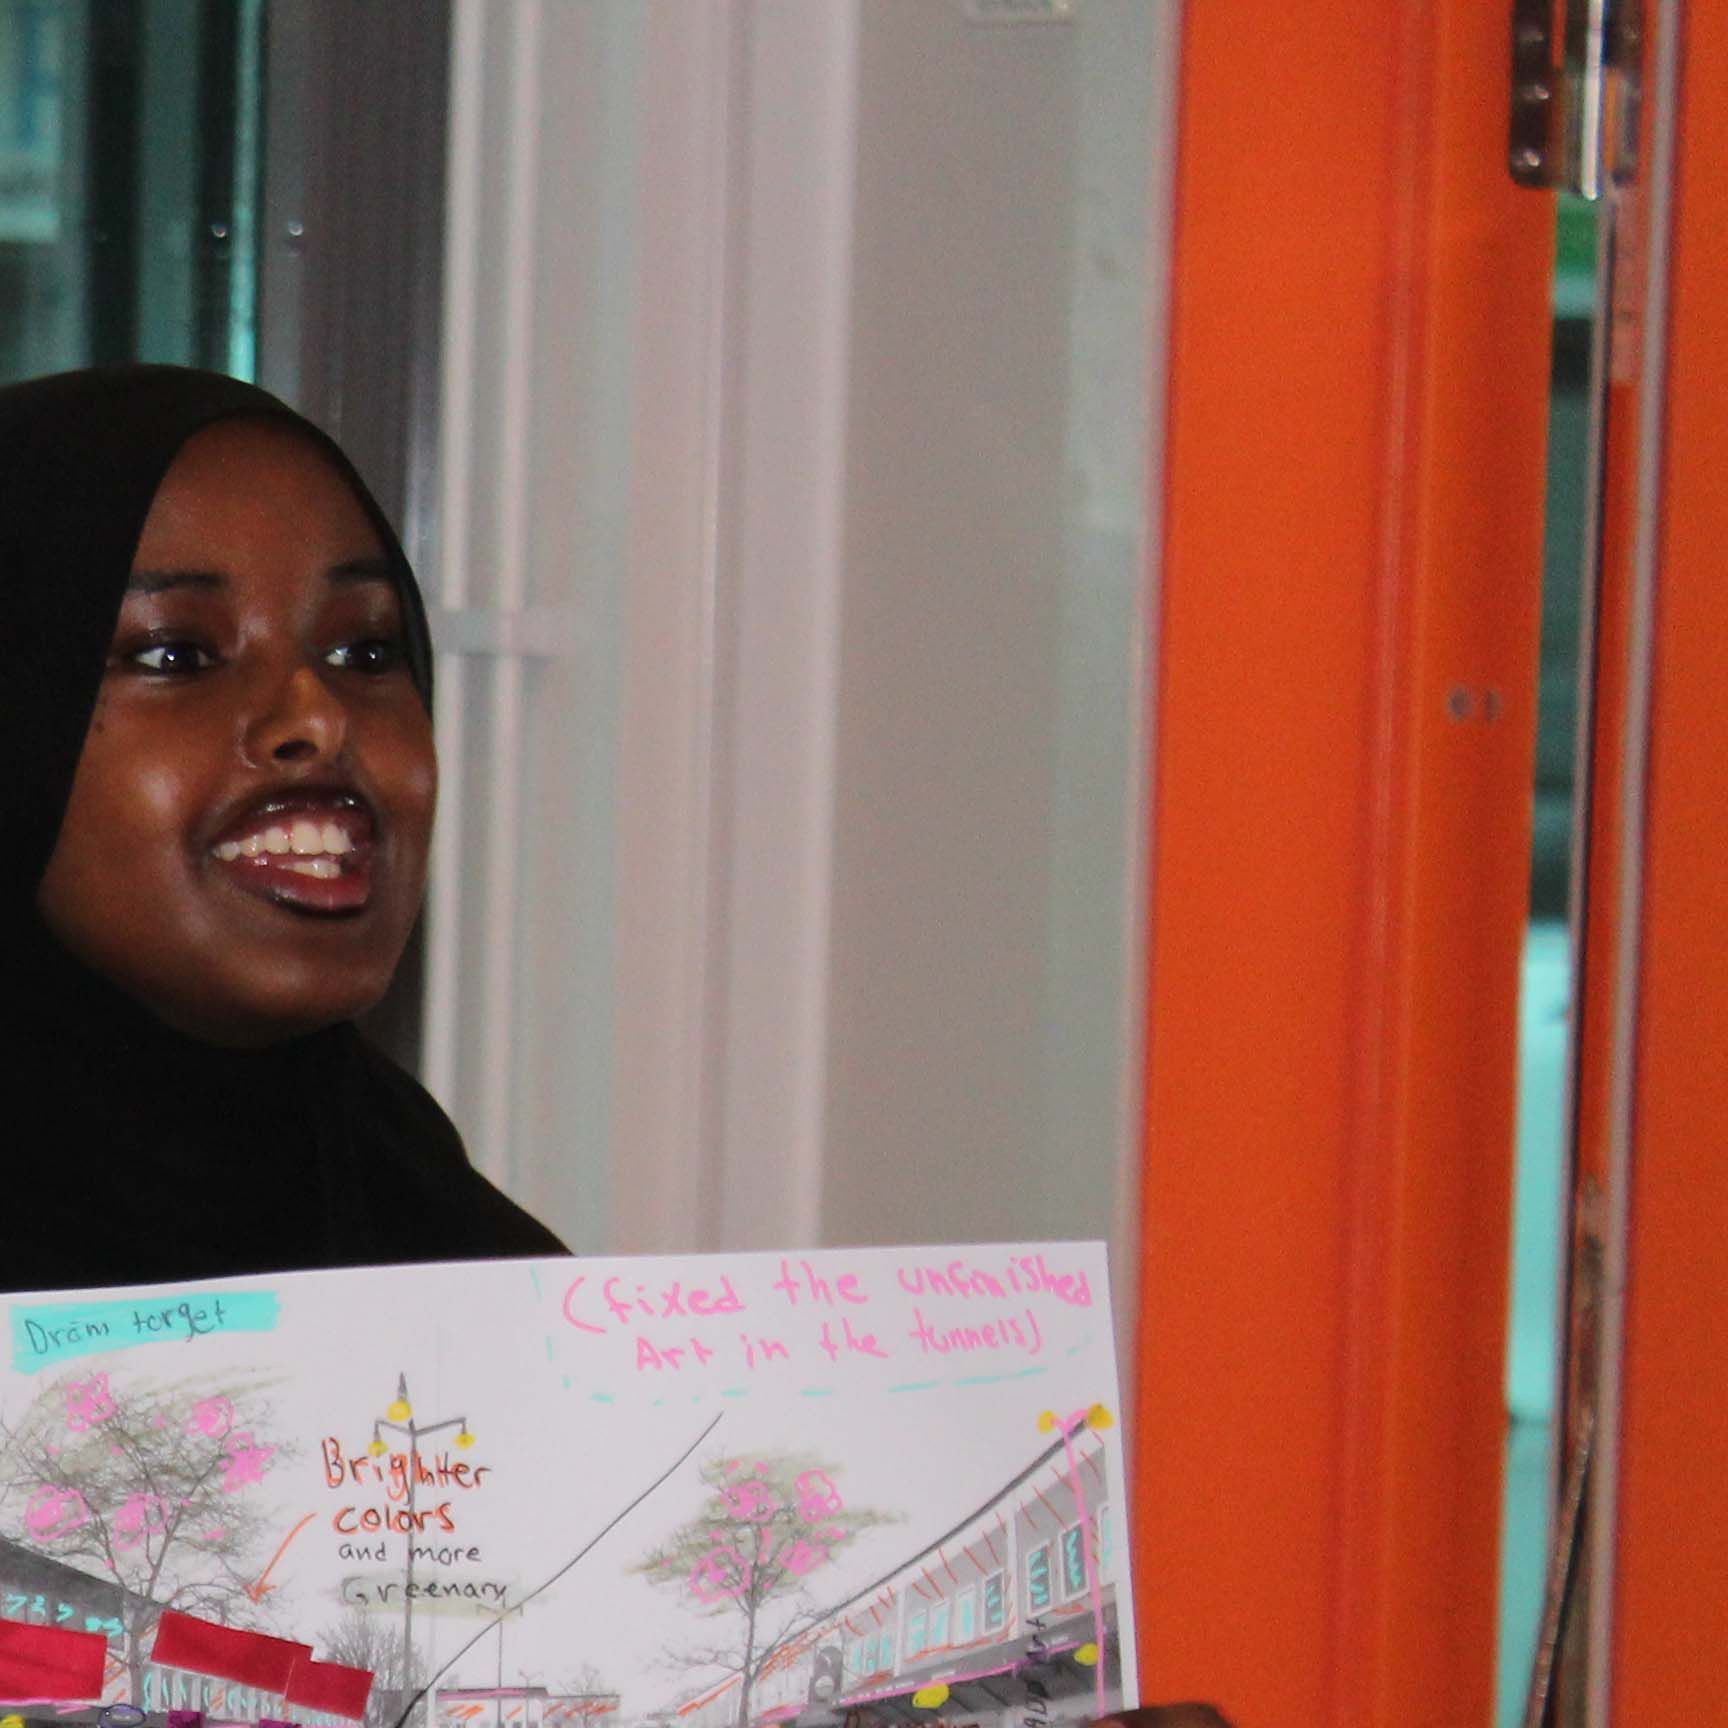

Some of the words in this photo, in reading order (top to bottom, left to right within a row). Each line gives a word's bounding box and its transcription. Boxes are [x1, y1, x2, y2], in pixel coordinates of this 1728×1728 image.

[772, 1259, 869, 1306] the
[635, 1335, 713, 1371] Art
[740, 1332, 791, 1371] in
[820, 1316, 889, 1361] the
[338, 1541, 387, 1562] and
[408, 1545, 483, 1566] more
